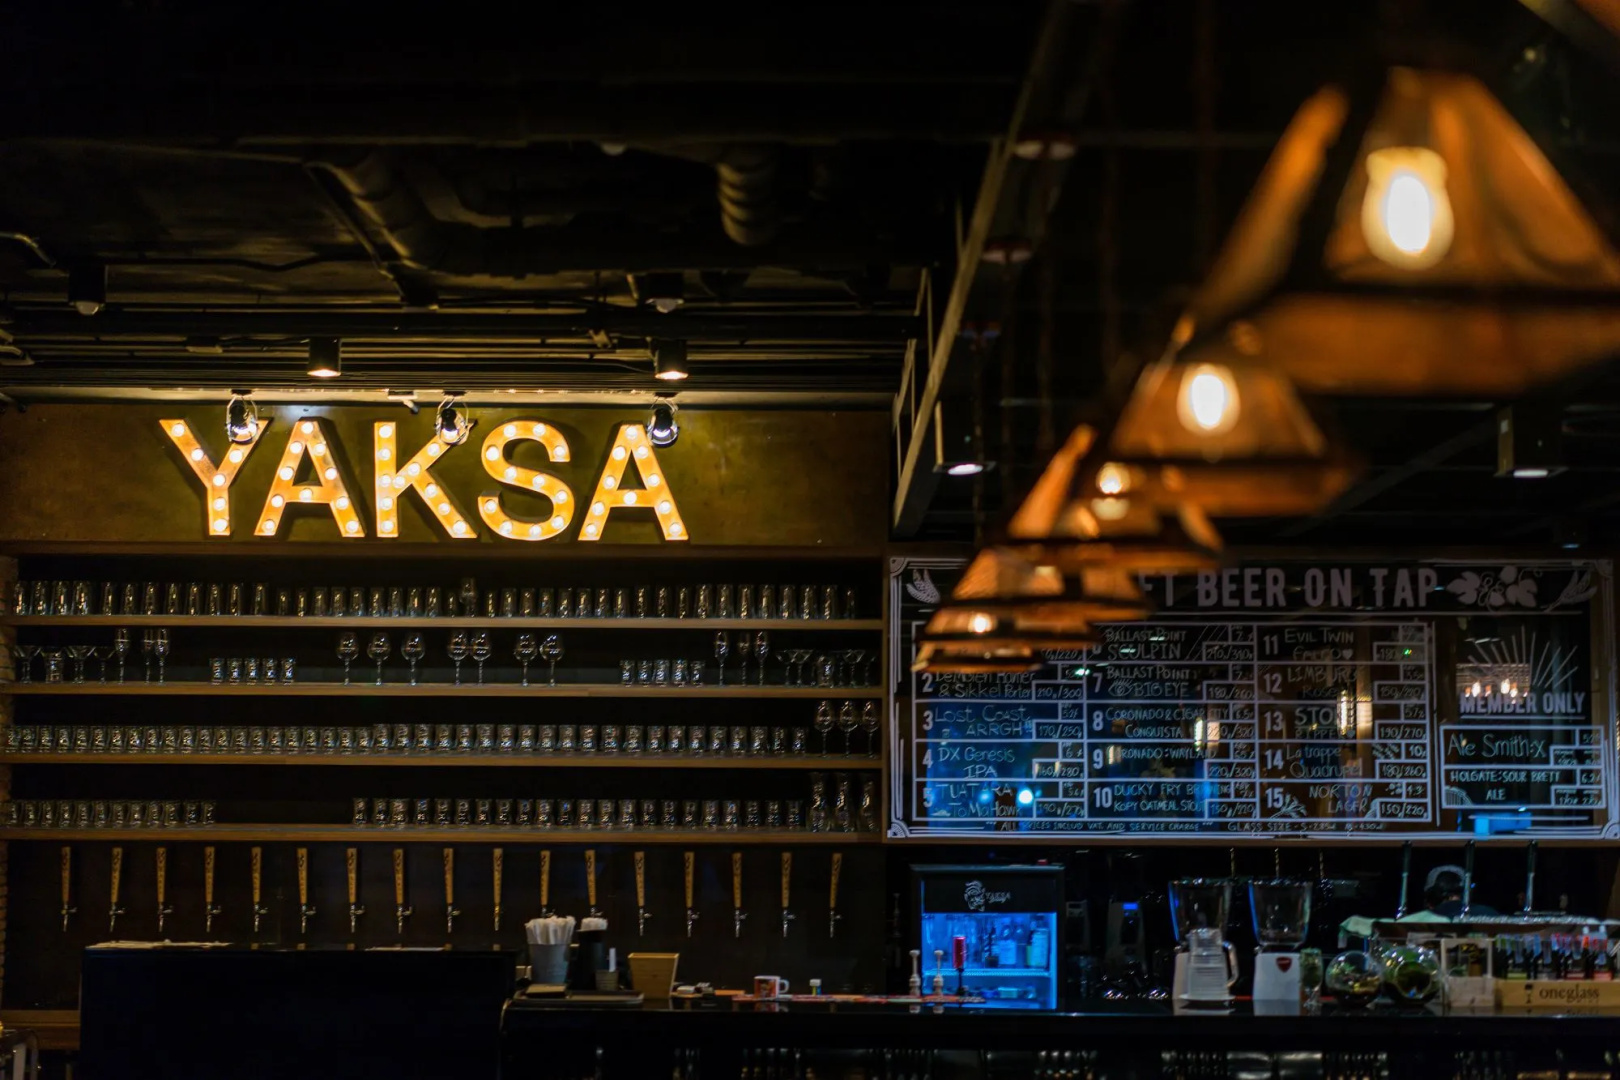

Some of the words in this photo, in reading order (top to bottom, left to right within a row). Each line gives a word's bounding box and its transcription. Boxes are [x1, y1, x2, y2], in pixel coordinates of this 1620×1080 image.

[159, 417, 689, 541] YAKSA
[1196, 568, 1287, 607] BEER
[1304, 568, 1352, 607] ON
[1369, 568, 1437, 607] TAP
[1263, 635, 1278, 655] 11
[922, 673, 933, 693] 2
[1093, 673, 1102, 693] 7
[1107, 667, 1152, 679] BALLAST
[1264, 673, 1282, 693] 12
[1460, 692, 1537, 713] MEMBER
[1543, 692, 1585, 714] ONLY
[923, 711, 933, 730] 3
[1093, 711, 1103, 731] 8
[1264, 711, 1283, 731] 13
[922, 749, 933, 768] 4
[1093, 749, 1103, 769] 9
[1265, 750, 1283, 769] 14
[964, 765, 997, 778] IPA
[1093, 787, 1112, 808] 10
[1265, 787, 1283, 808] 15
[1486, 788, 1506, 800] ALE
[1539, 985, 1599, 1002] oneglass
